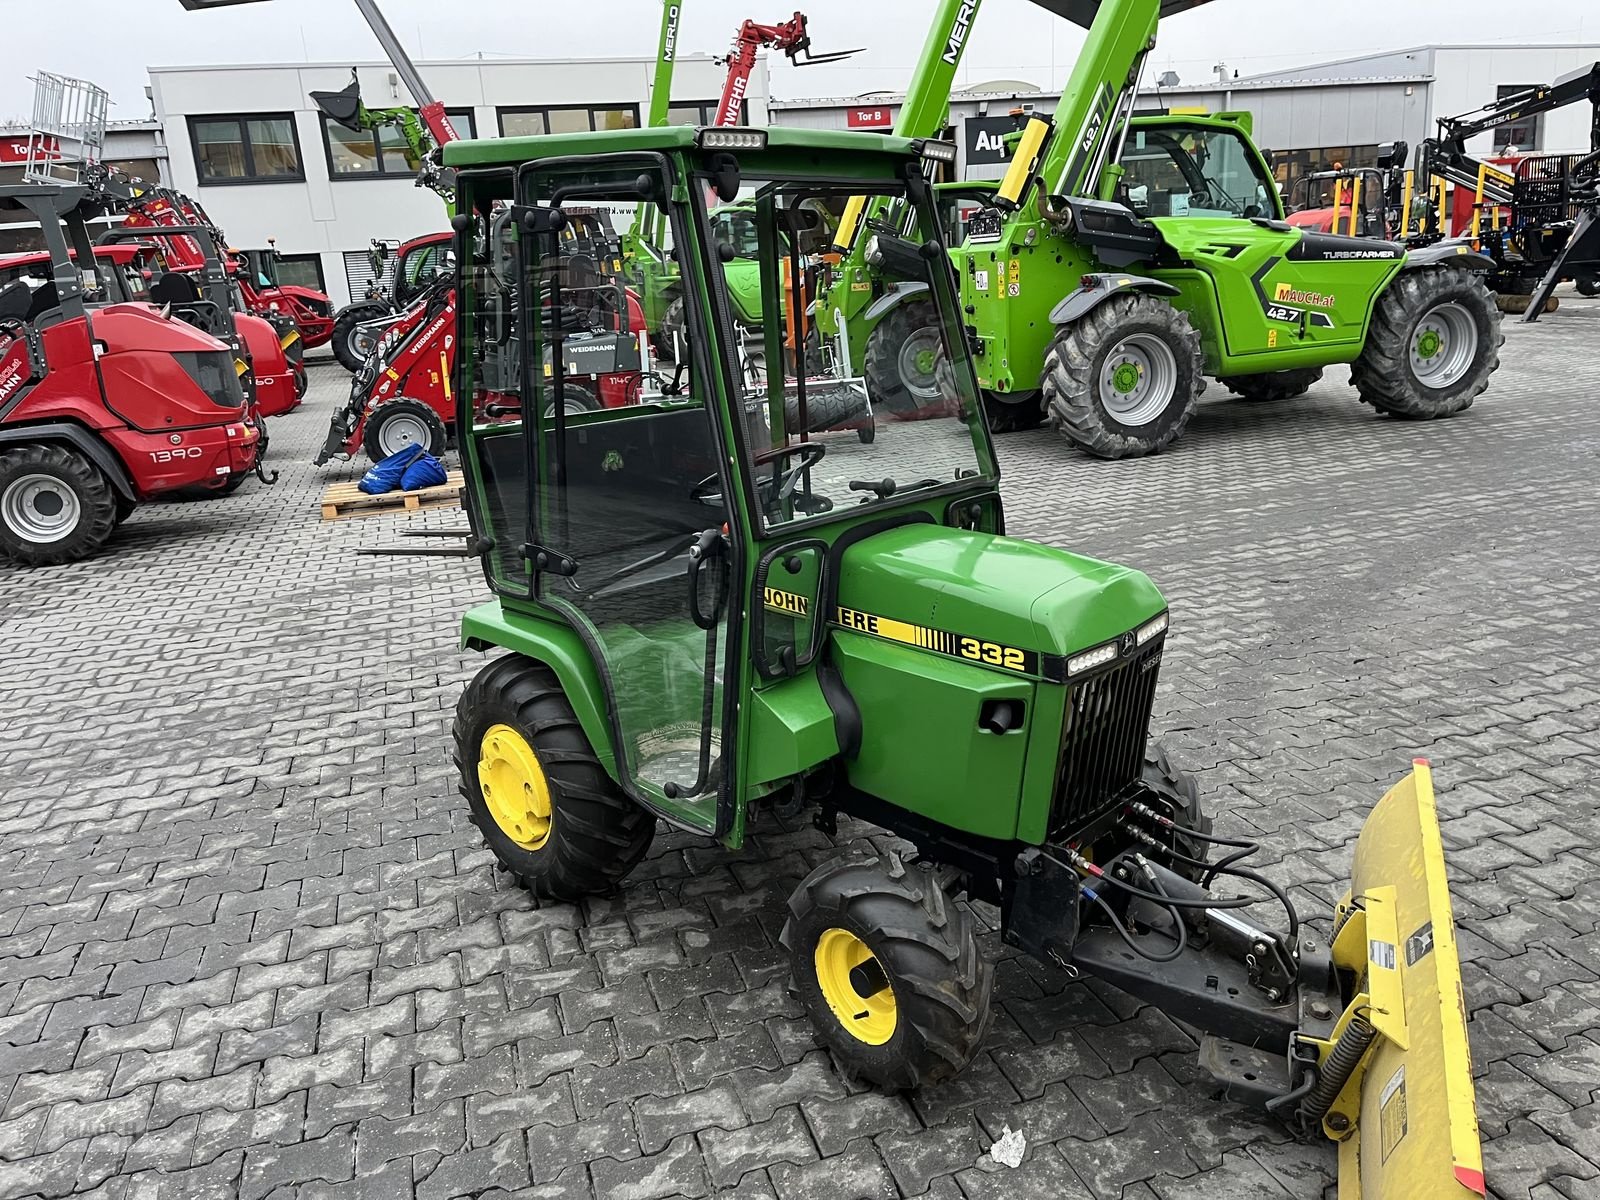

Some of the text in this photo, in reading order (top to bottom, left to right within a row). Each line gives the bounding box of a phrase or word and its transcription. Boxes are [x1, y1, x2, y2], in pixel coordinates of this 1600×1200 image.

[663, 5, 679, 62] MERLO
[857, 111, 882, 121] Tor B
[1083, 112, 1102, 152] 42.7
[1323, 250, 1395, 259] TURBOFARMER
[1278, 289, 1335, 307] MAUCH.at
[1267, 307, 1299, 321] 42.7
[409, 317, 446, 355] WEIDEMANN
[569, 344, 616, 354] WEIDEMANN
[149, 446, 203, 463] 1390
[764, 586, 808, 614] JOHN
[960, 636, 1025, 671] 332
